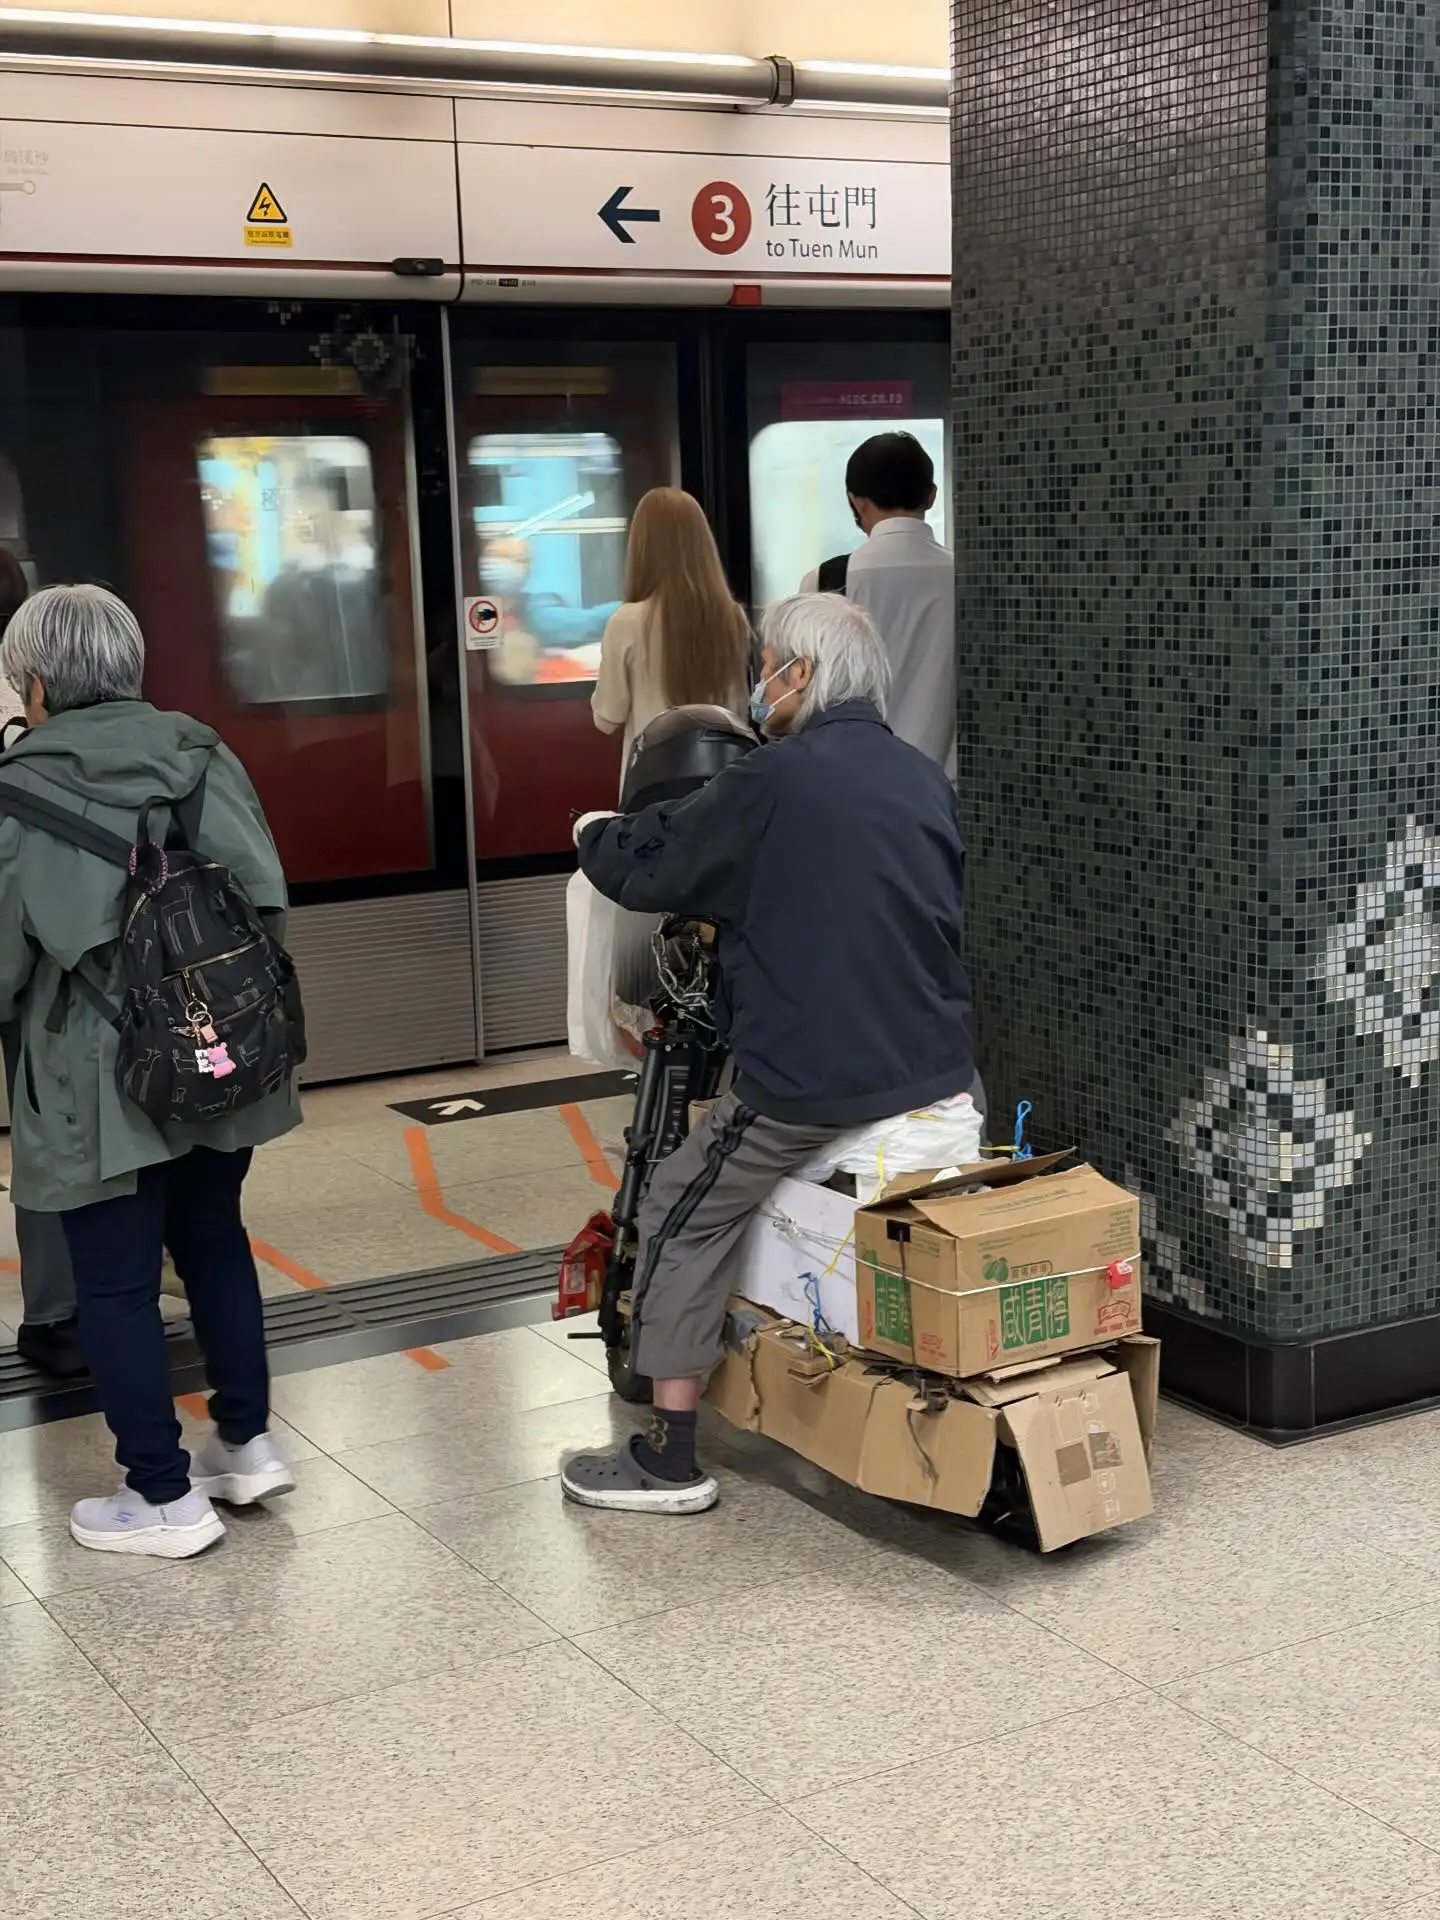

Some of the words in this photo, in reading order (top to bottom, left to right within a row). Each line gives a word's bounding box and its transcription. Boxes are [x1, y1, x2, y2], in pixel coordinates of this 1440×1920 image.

[710, 194, 736, 242] 3
[765, 183, 877, 229] 往屯門
[766, 240, 785, 257] to
[788, 238, 833, 258] Tuen
[839, 239, 878, 259] Mun
